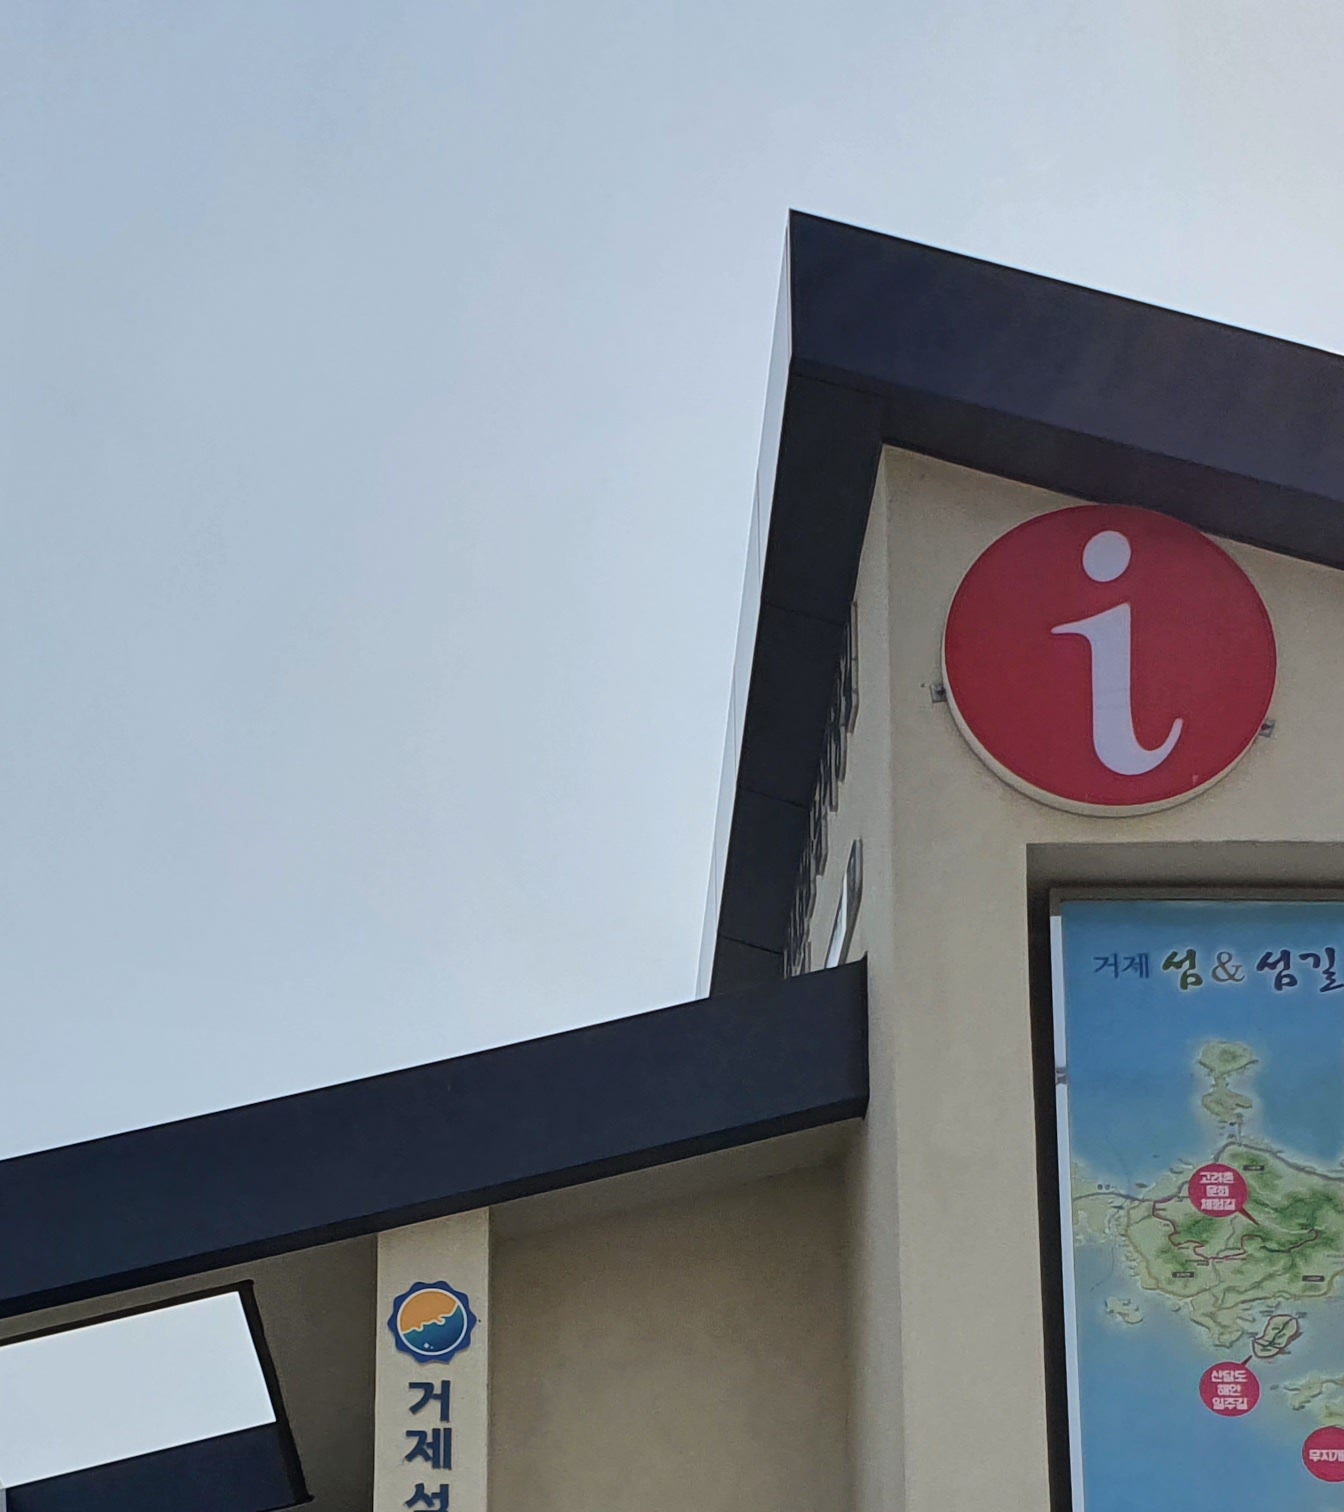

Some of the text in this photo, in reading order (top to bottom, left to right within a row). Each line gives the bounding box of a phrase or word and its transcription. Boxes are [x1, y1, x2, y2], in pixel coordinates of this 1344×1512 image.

[1051, 530, 1183, 776] i
[1093, 953, 1149, 978] 거제
[404, 1380, 452, 1471] 거제
